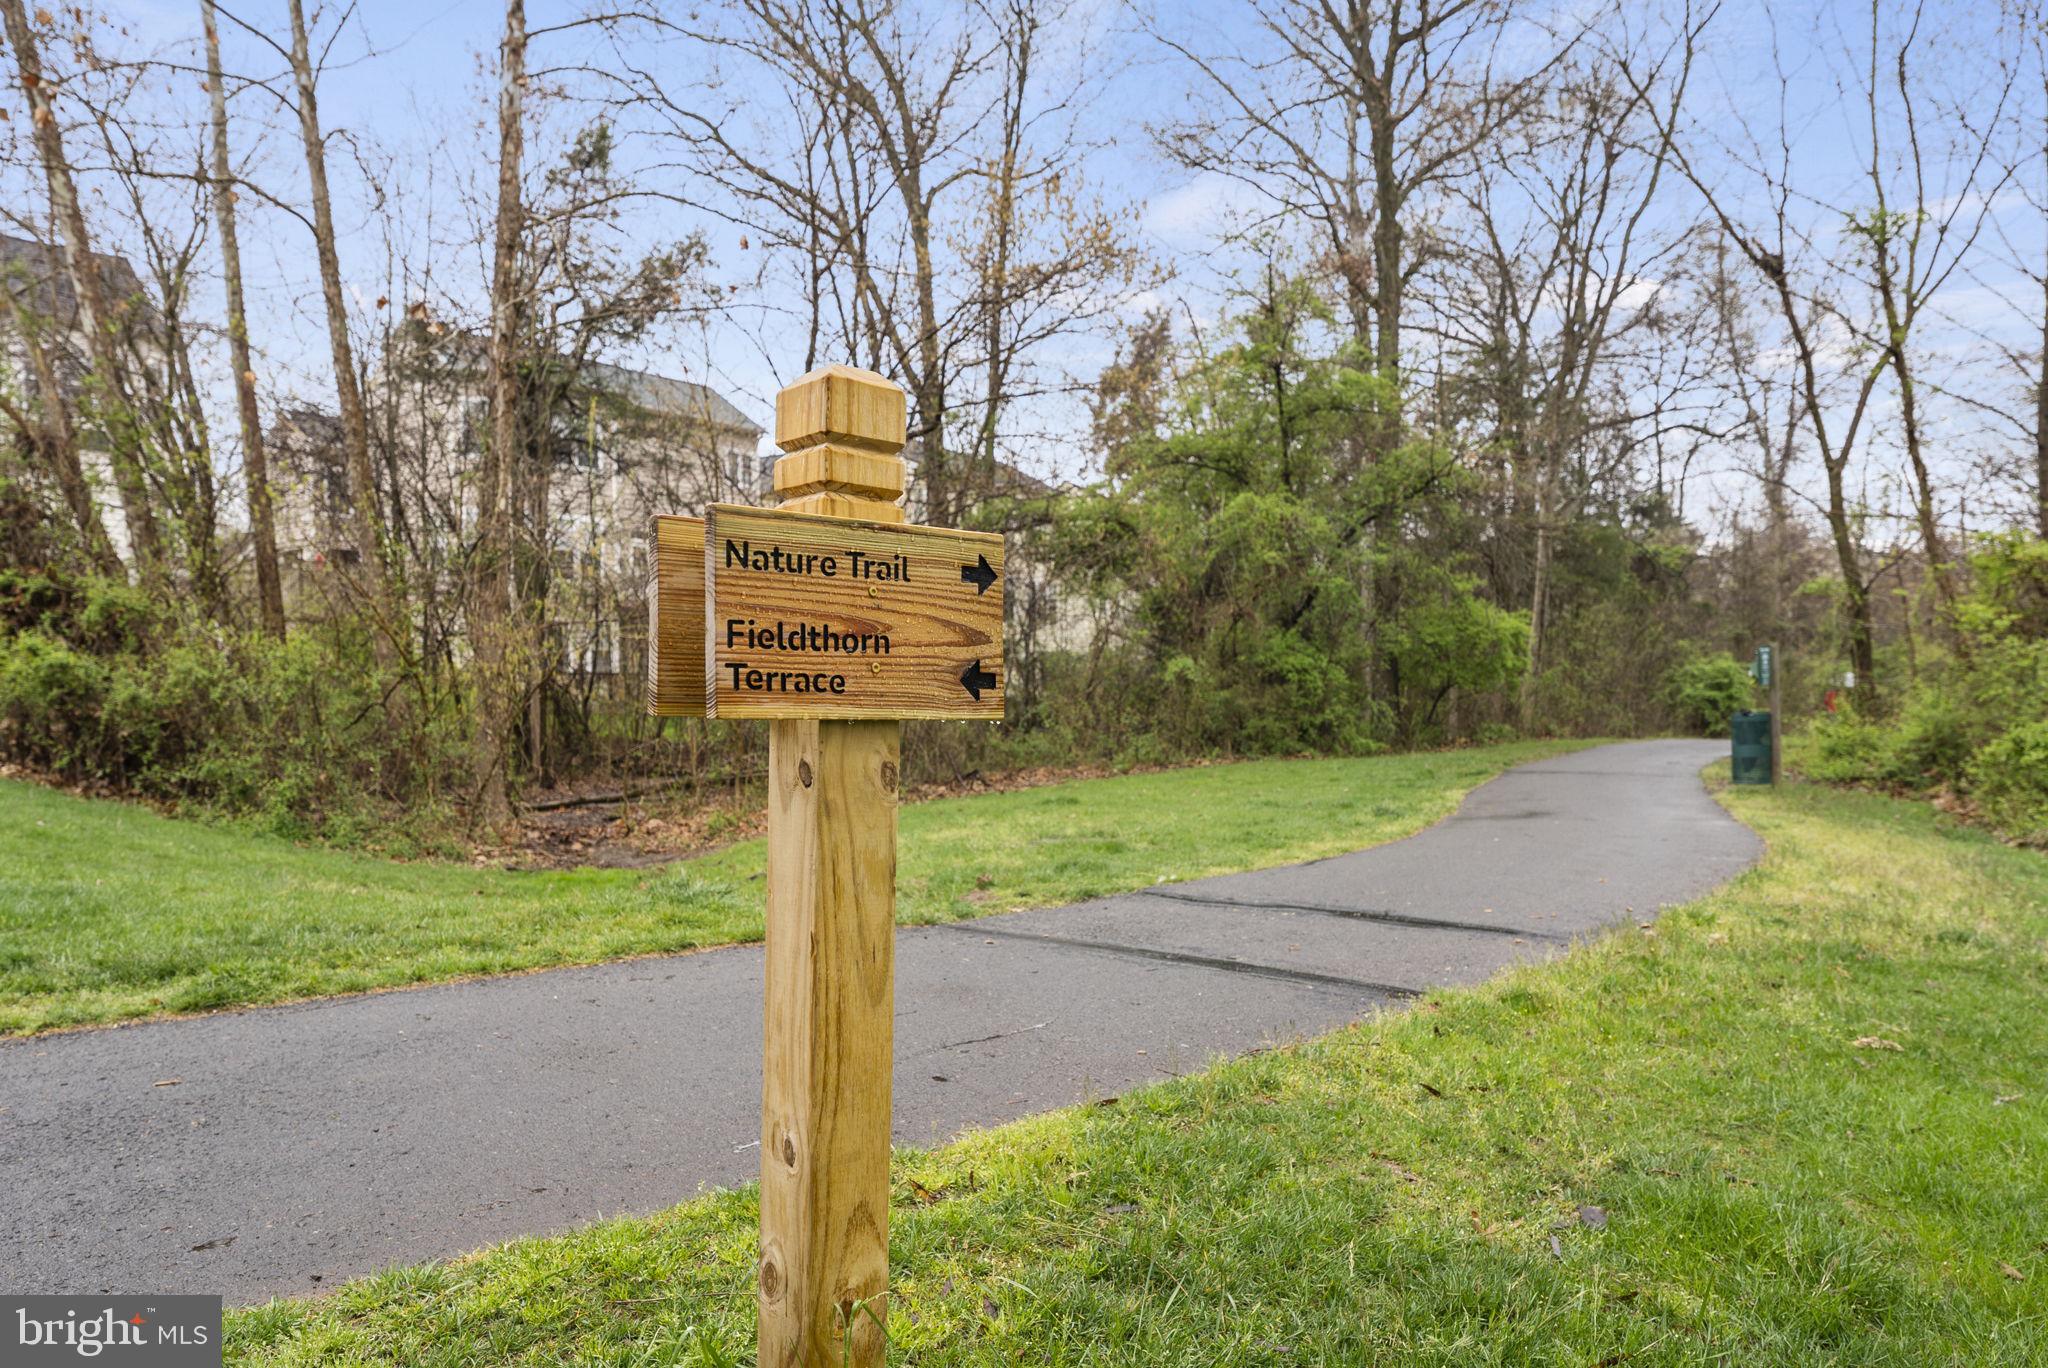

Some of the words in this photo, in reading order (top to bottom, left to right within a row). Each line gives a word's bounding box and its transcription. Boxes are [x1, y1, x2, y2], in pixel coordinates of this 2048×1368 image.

[725, 539, 836, 577] Nature
[845, 551, 911, 582] Trail
[726, 619, 890, 654] Fieldthorn
[725, 662, 845, 694] Terrace
